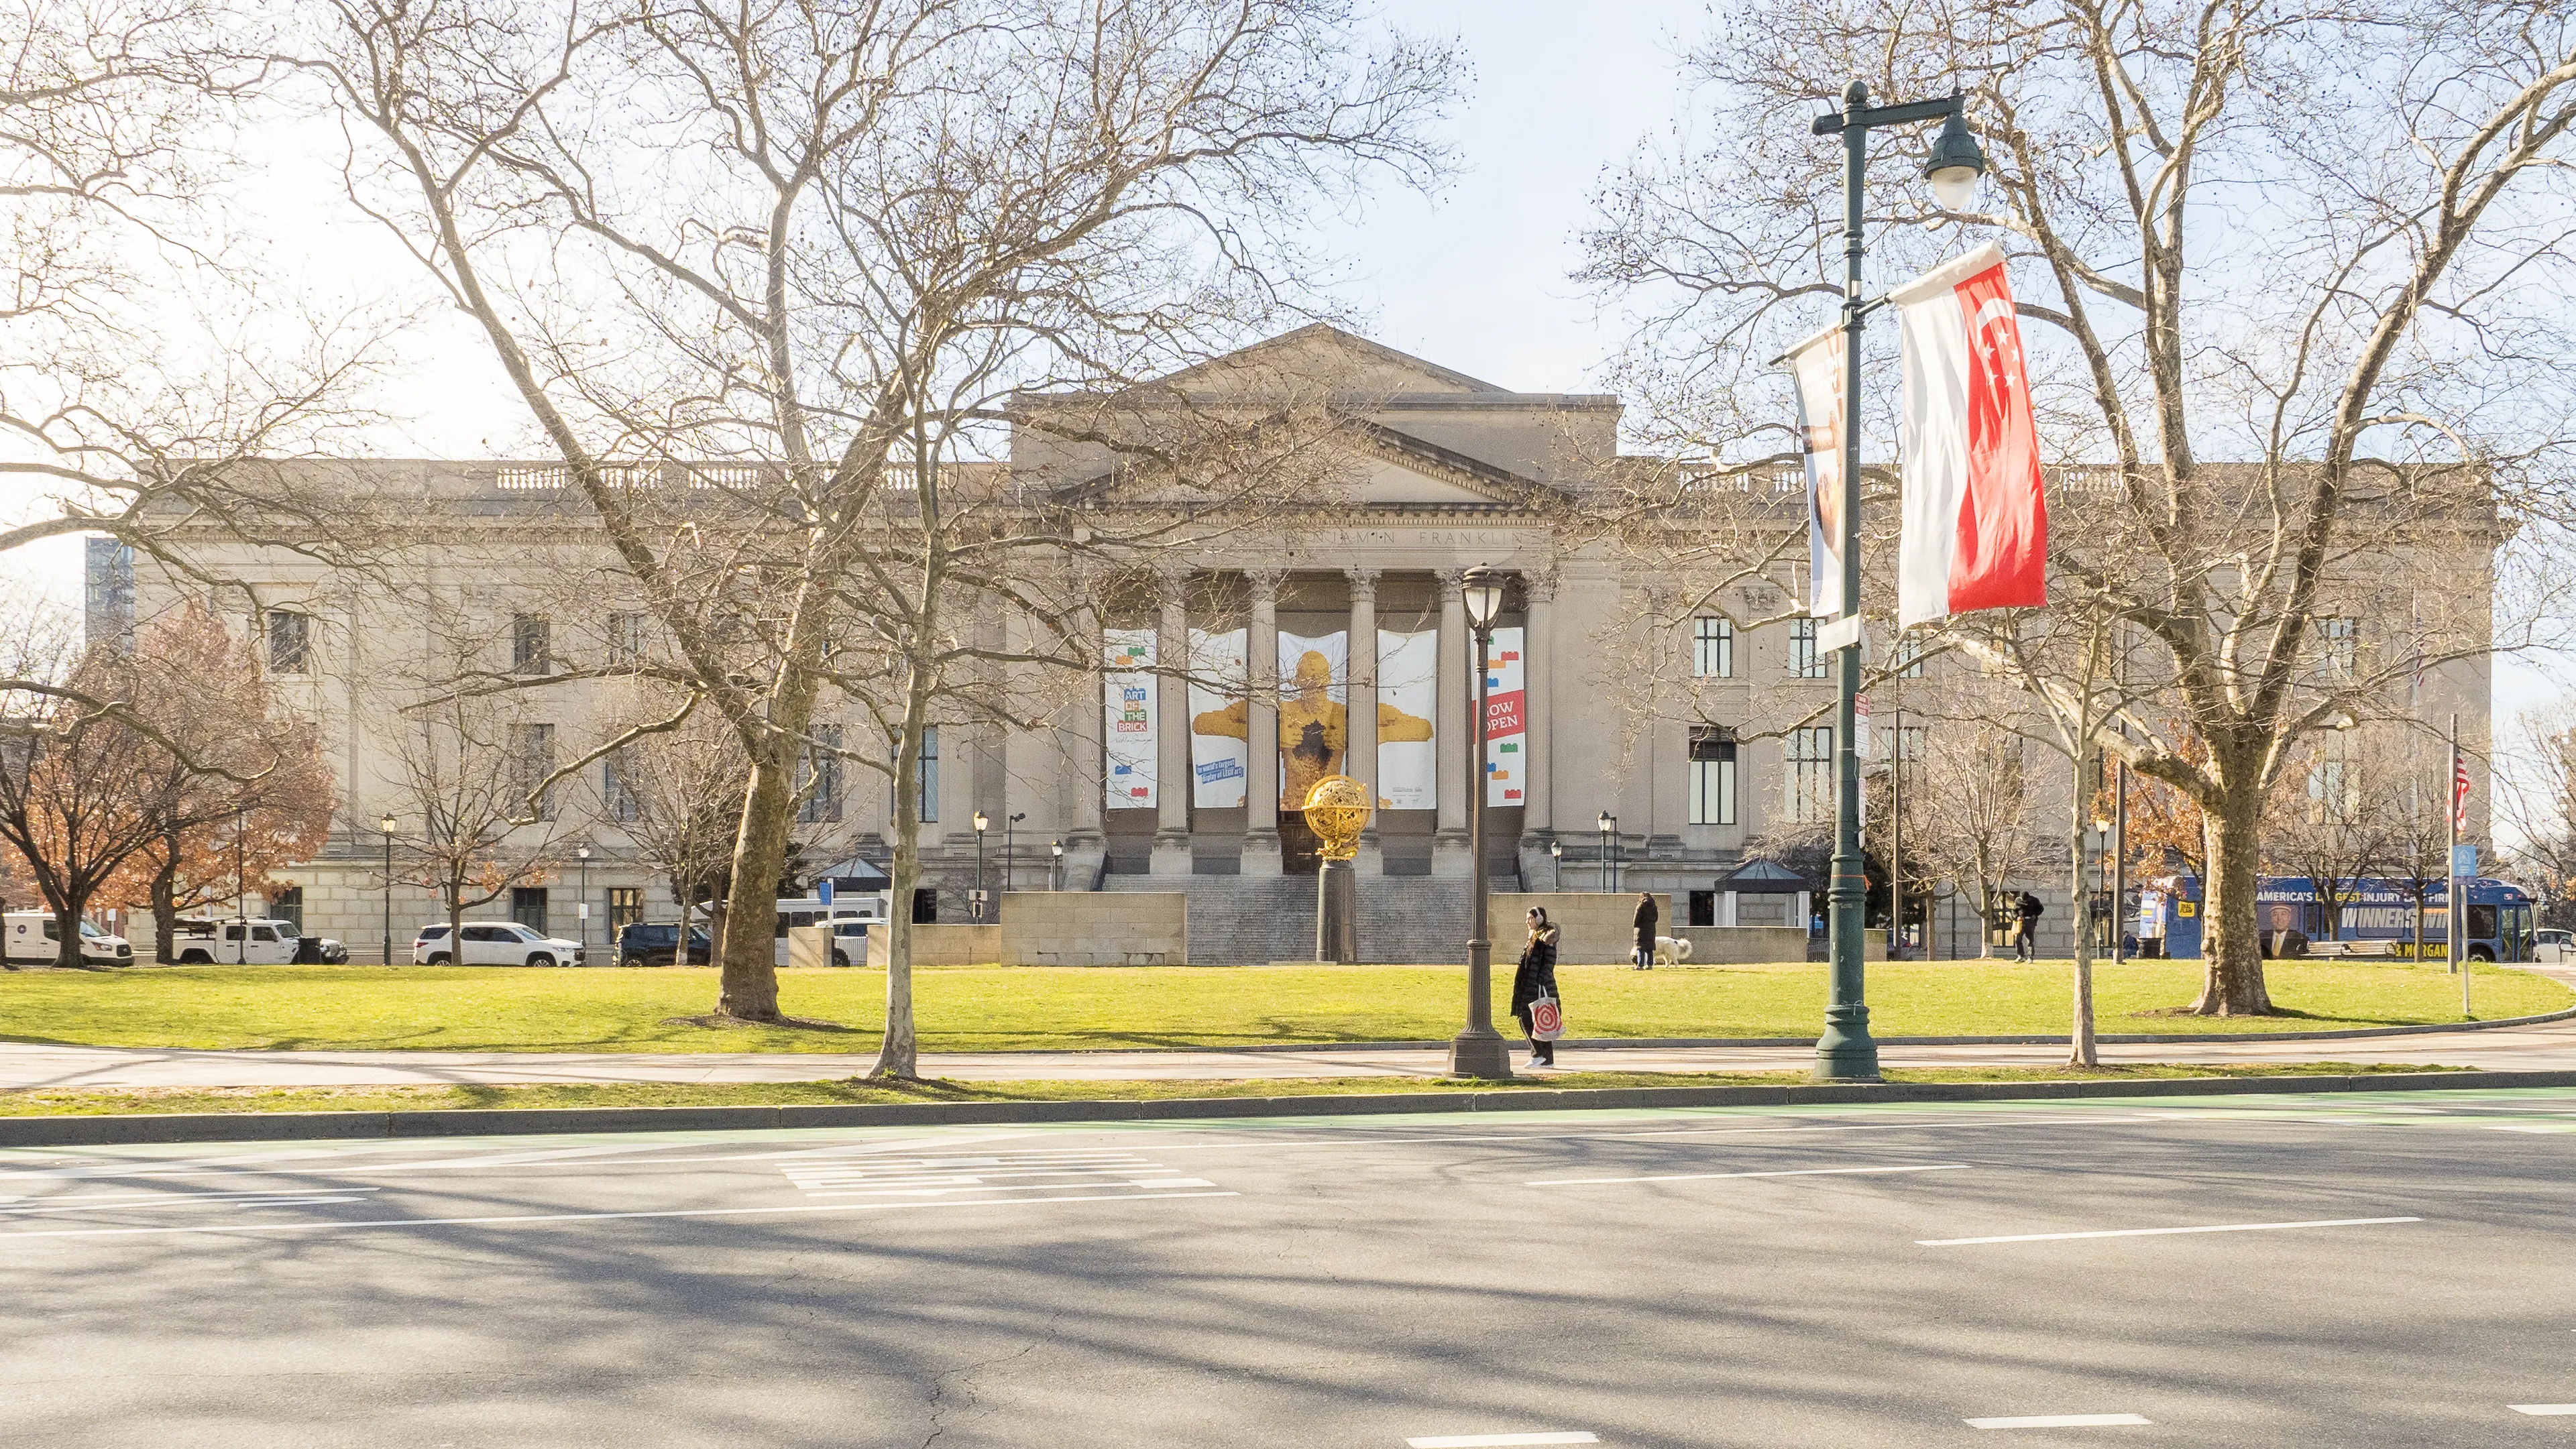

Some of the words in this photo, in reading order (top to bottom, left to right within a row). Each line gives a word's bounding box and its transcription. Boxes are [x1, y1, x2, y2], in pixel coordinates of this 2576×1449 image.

[1419, 531, 1522, 544] FRANKLIN
[1125, 691, 1145, 701] ART
[1125, 701, 1139, 711] OF
[1125, 711, 1145, 721] THE
[1118, 722, 1147, 732] BRICK
[2256, 891, 2313, 902] AMERICA'S
[2315, 892, 2361, 903] LGEST
[2363, 892, 2400, 902] INJURY
[2404, 893, 2426, 903] LA
[2341, 907, 2416, 928] WINNERS
[2395, 944, 2402, 957] &
